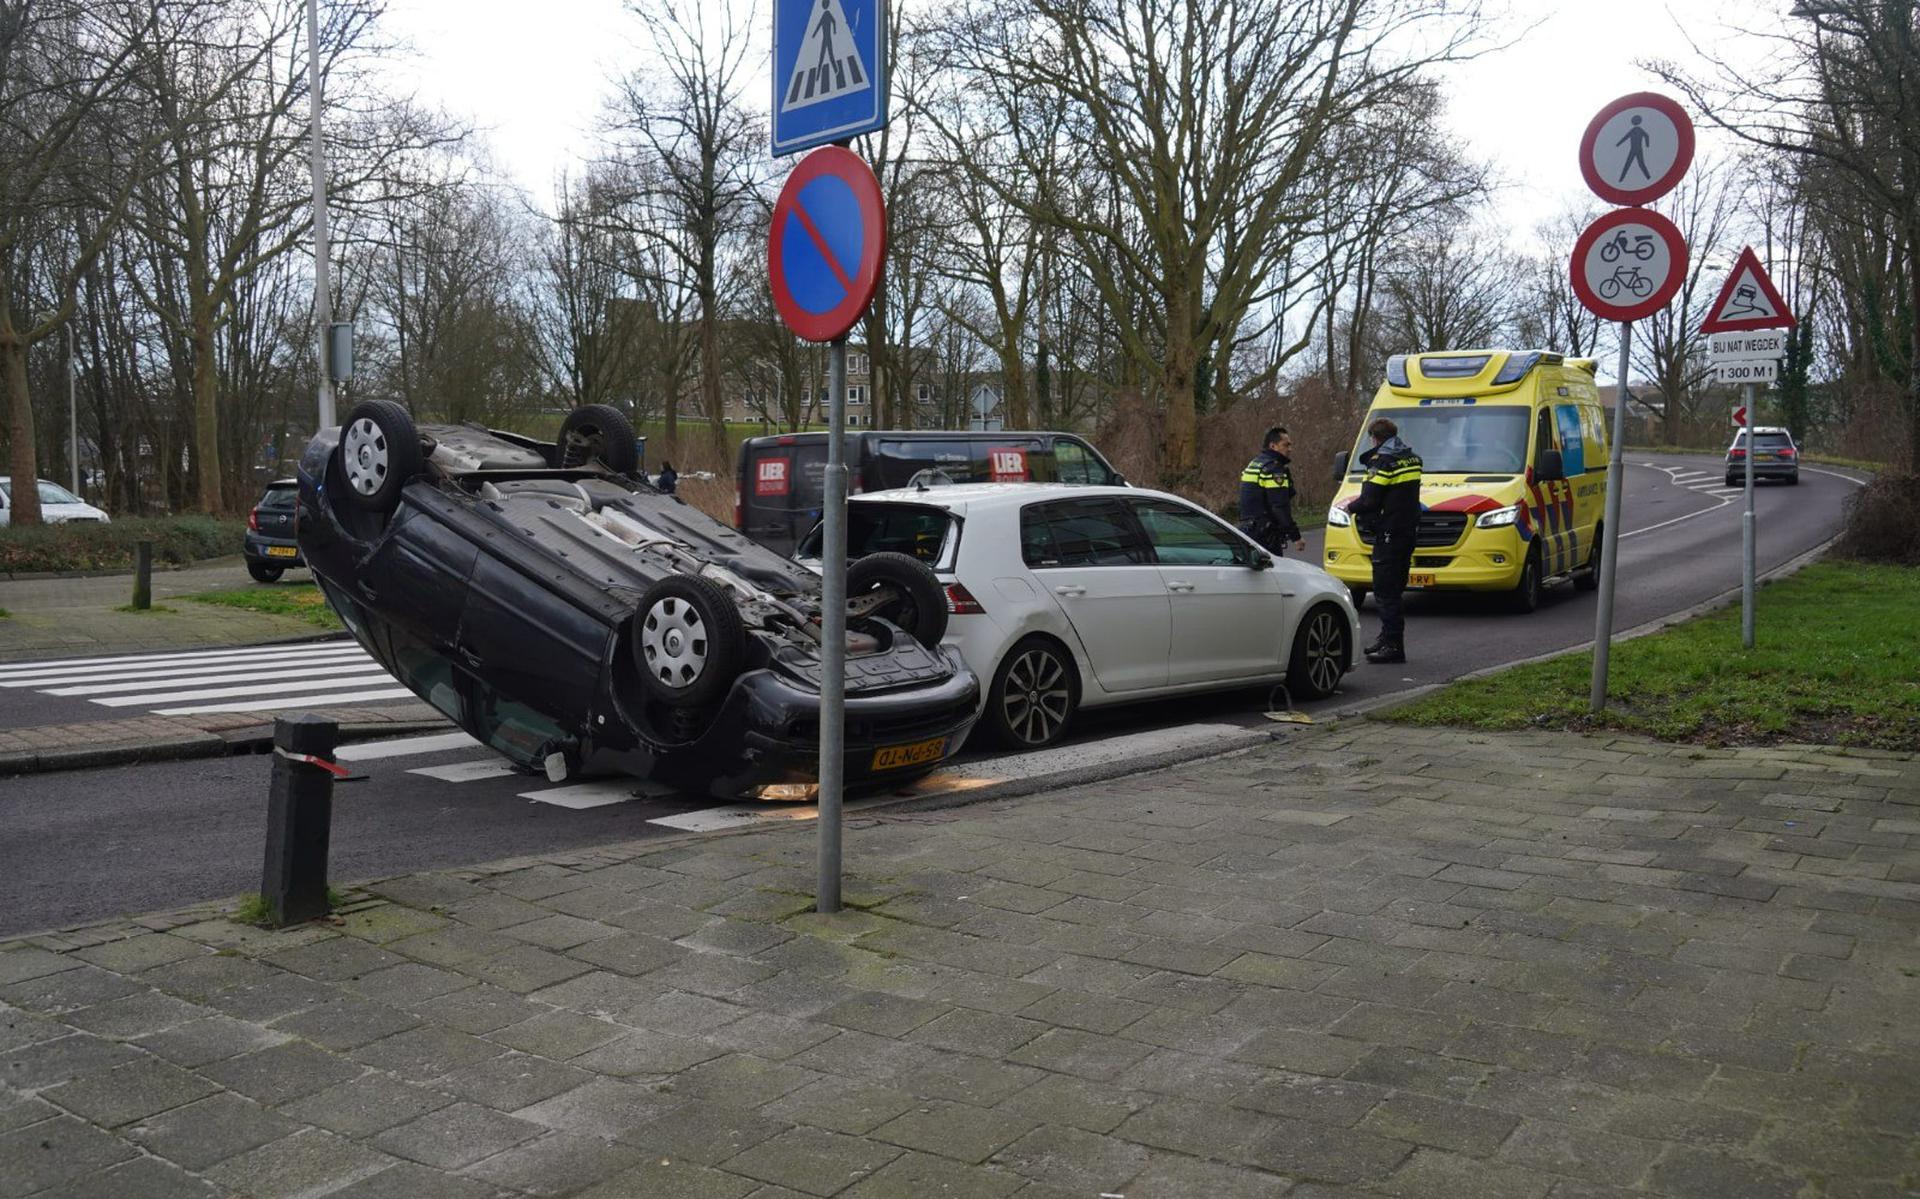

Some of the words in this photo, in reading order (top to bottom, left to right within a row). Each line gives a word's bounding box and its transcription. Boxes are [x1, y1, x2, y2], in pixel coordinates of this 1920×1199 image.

[1727, 340, 1743, 352] NAT
[1744, 338, 1780, 352] WEGDEK
[1727, 367, 1750, 379] 300
[1753, 366, 1765, 378] M
[759, 462, 785, 480] LIER
[993, 452, 1024, 474] LIER
